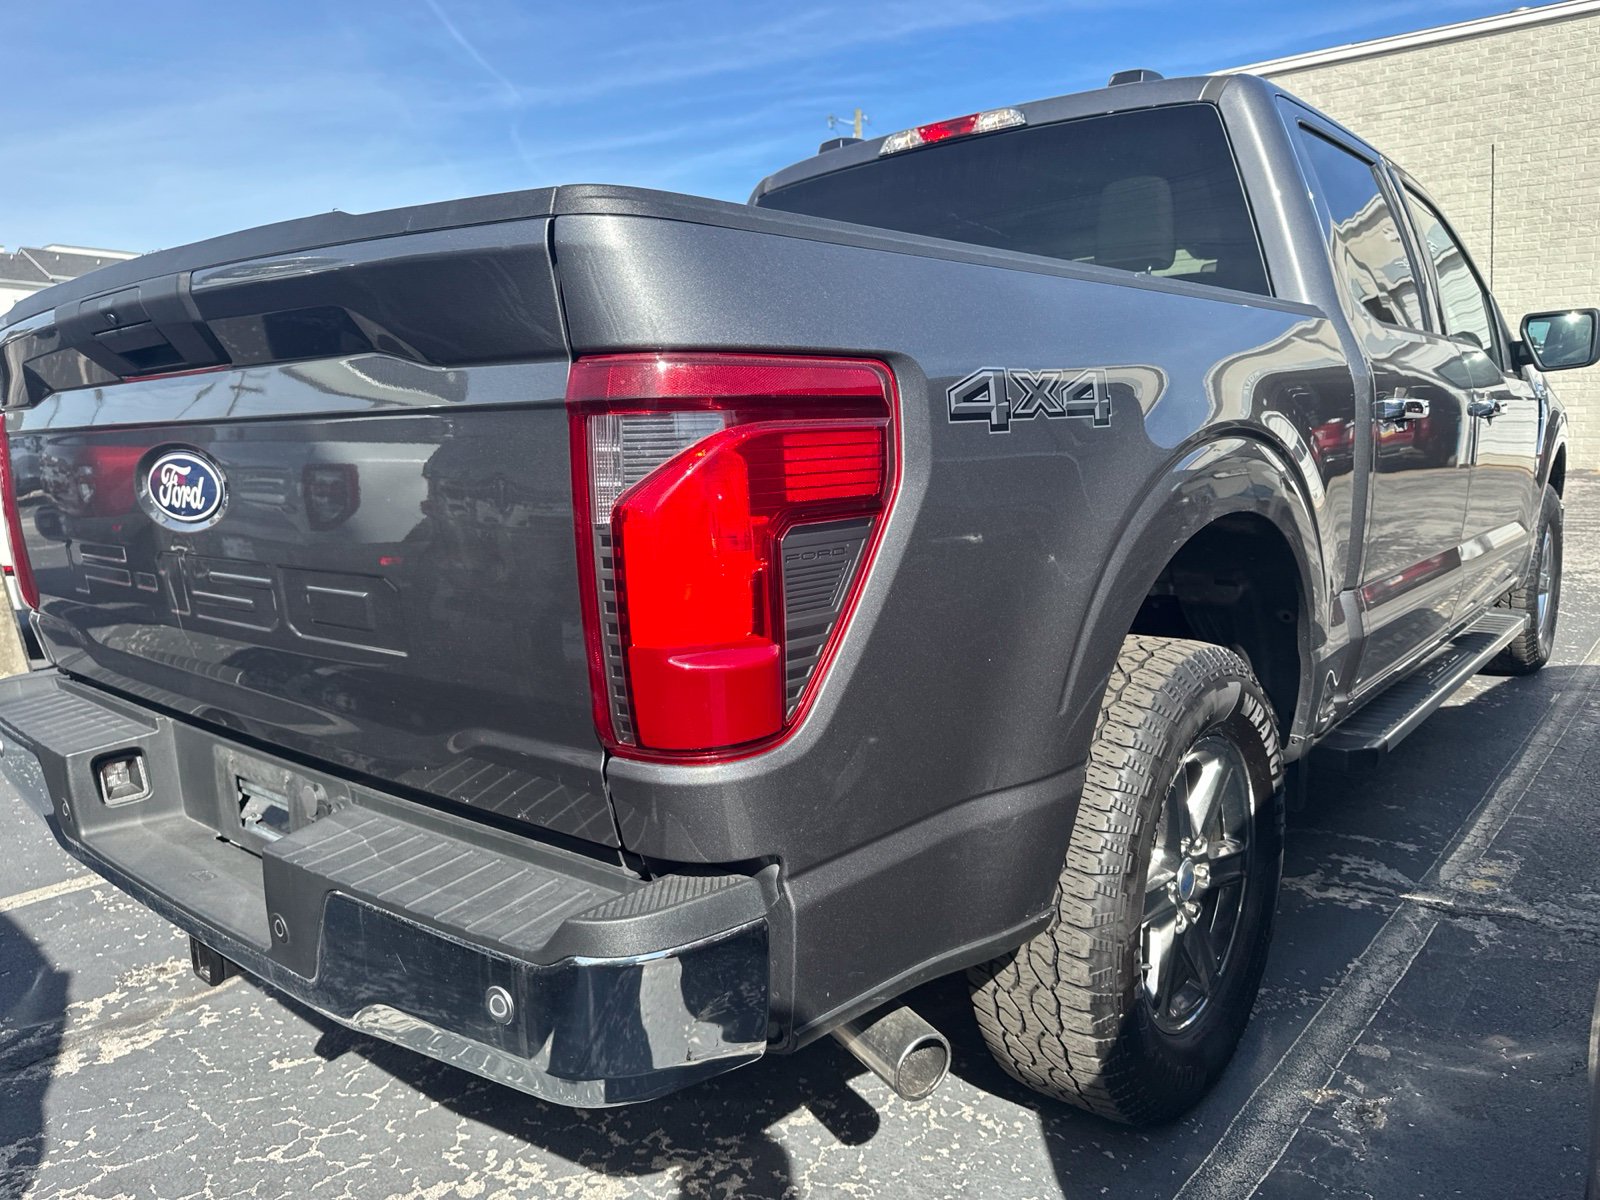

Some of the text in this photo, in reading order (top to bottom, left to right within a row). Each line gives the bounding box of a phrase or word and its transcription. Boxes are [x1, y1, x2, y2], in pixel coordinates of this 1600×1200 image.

[159, 463, 206, 510] Ford
[786, 547, 846, 563] FORD
[66, 538, 408, 657] F-150
